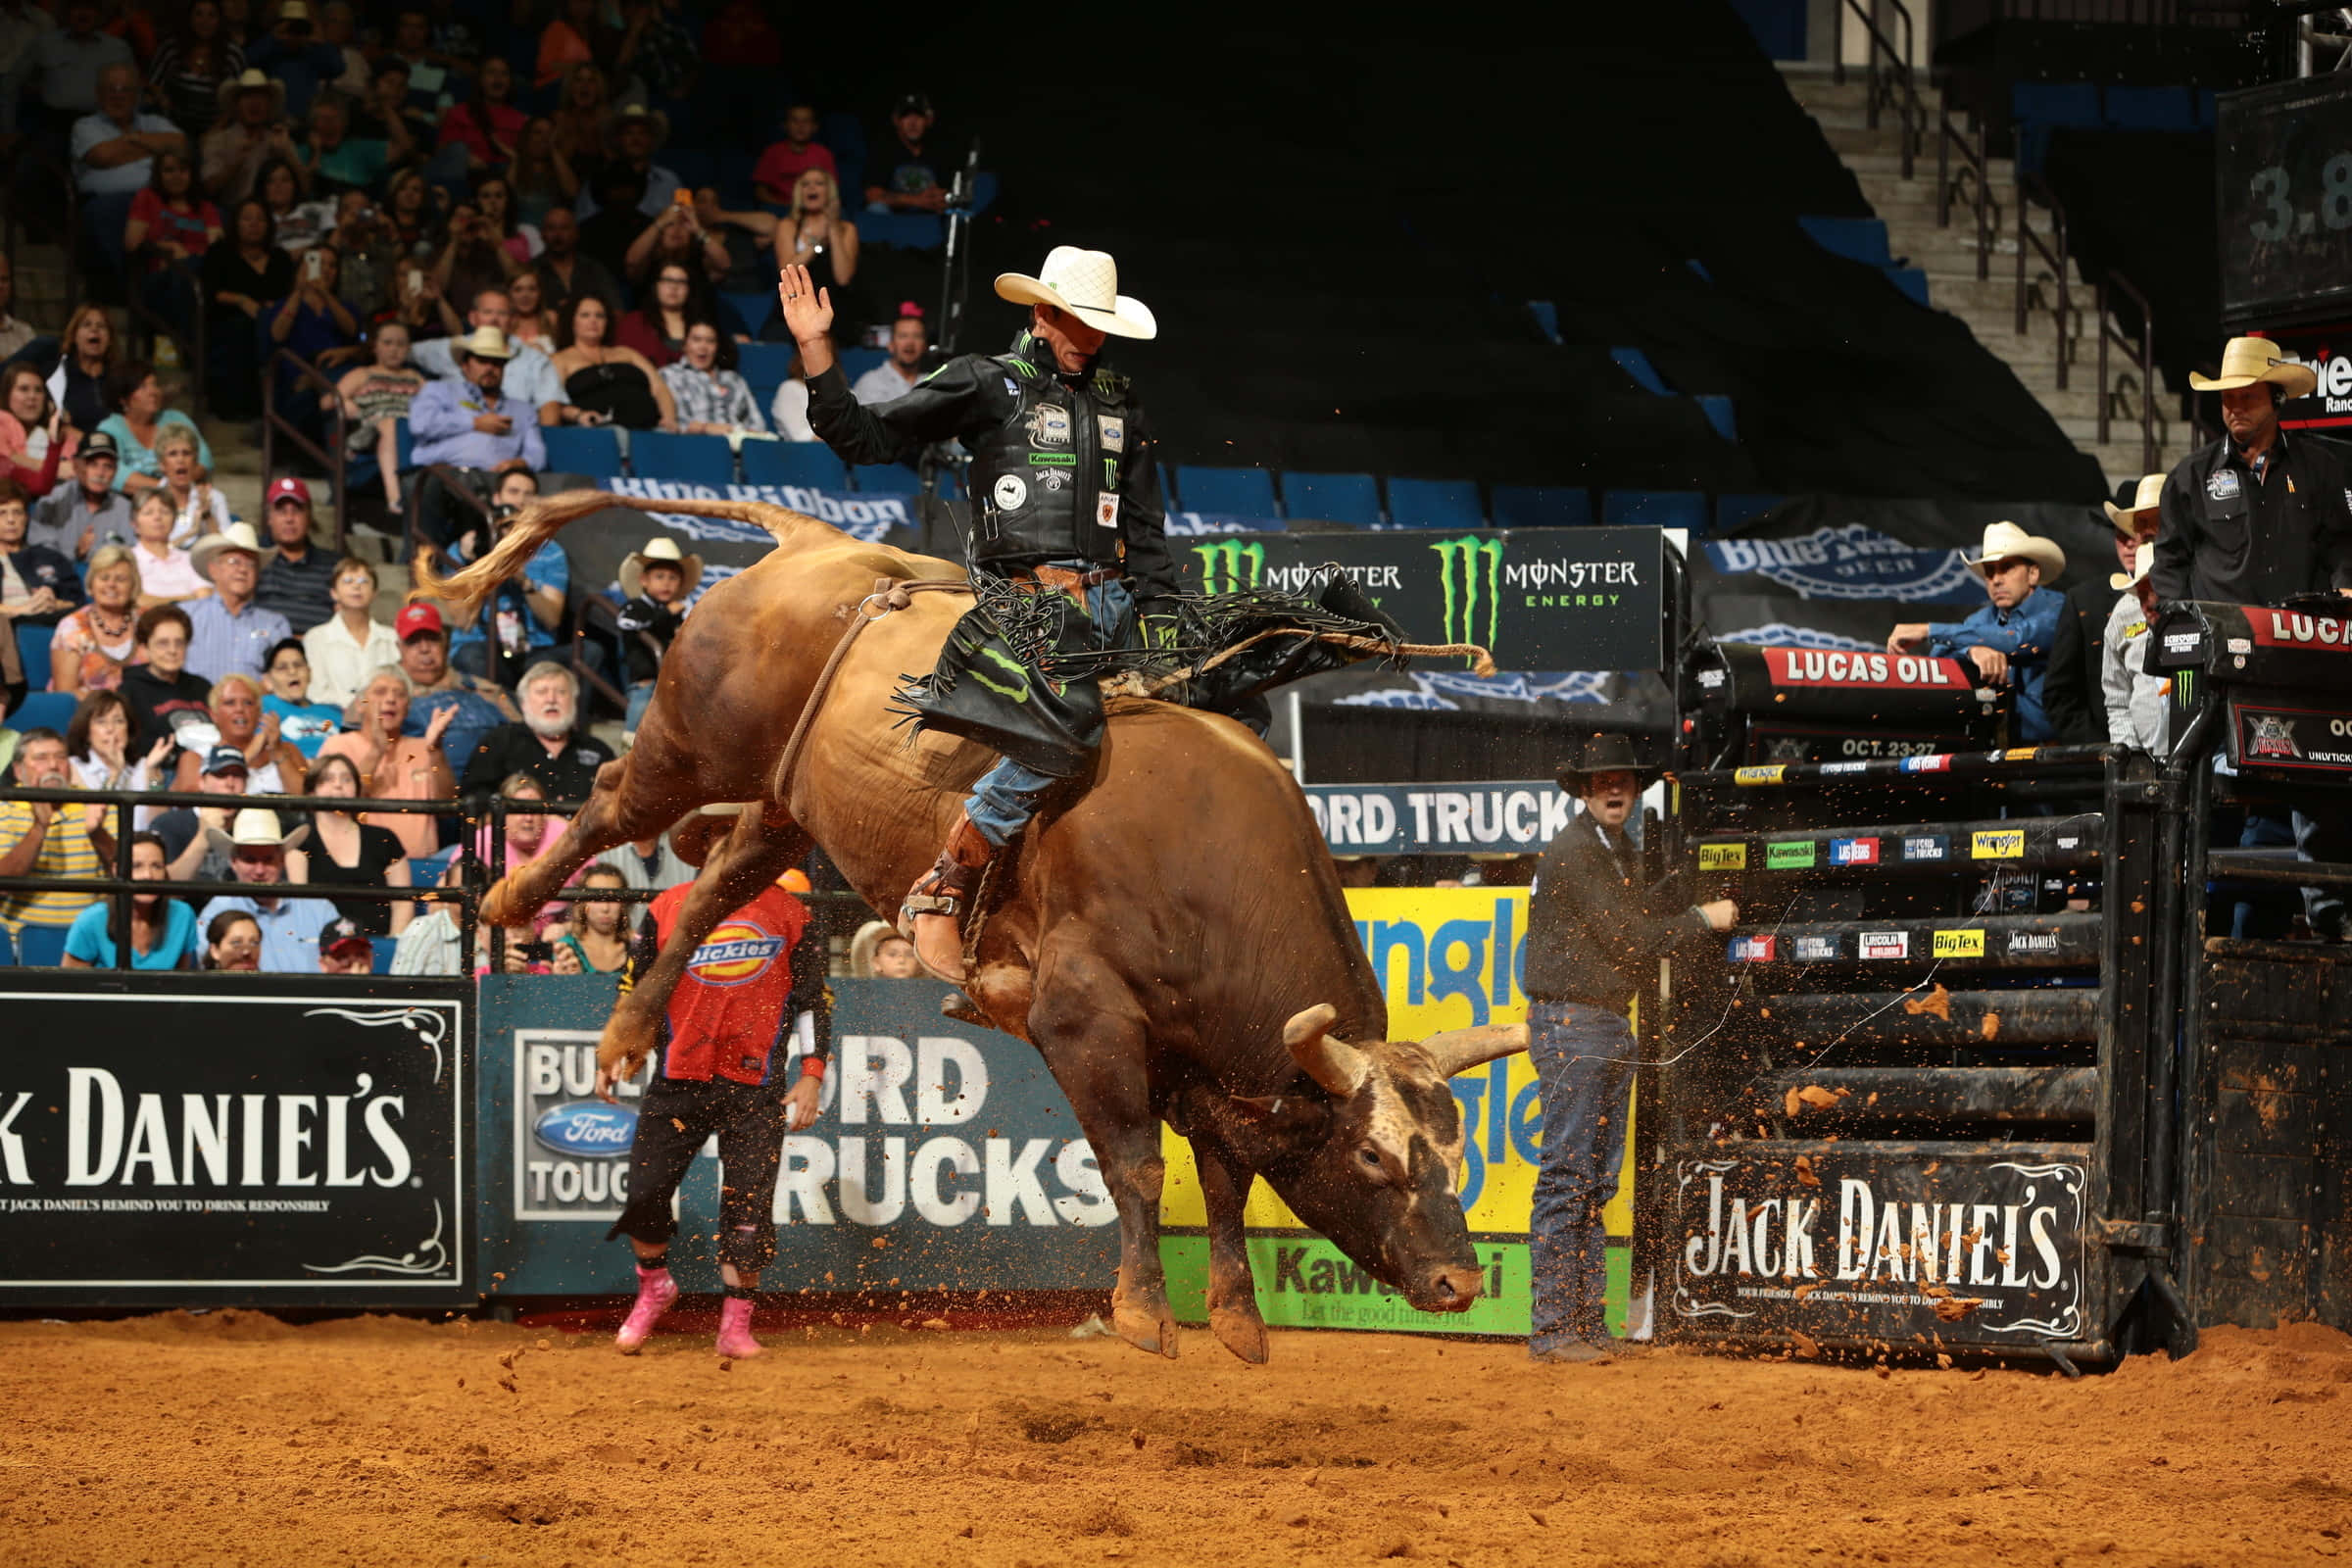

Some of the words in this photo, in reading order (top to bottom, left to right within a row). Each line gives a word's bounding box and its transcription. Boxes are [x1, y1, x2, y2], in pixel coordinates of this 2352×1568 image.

[1526, 594, 1620, 608] ENERGY
[1787, 651, 1888, 683] LUCAS
[1896, 657, 1949, 684] OIL
[1842, 739, 1883, 757] OCT.
[1888, 741, 1936, 758] 23-27
[1407, 790, 1587, 845] TRUCK
[1769, 844, 1813, 859] Kawasaki
[1838, 843, 1851, 860] LAS
[1975, 833, 2022, 856] Wrangler
[1865, 934, 1897, 947] LINCOLN
[2009, 933, 2028, 951] JACK
[564, 1112, 630, 1144] Ford
[700, 1133, 1121, 1227] RUCKS
[10, 1199, 41, 1213] JACK
[43, 1199, 100, 1211] DANIEL'S
[102, 1199, 154, 1211] REMIND
[155, 1199, 182, 1211] YOU
[184, 1200, 203, 1211] TO
[204, 1200, 246, 1211] DRINK
[248, 1200, 330, 1212] RESPONSIBLY
[1686, 1175, 1821, 1280] JACK
[1858, 1292, 1890, 1305] REMIND
[1910, 1295, 1921, 1305] TO
[1356, 1301, 1396, 1326] good
